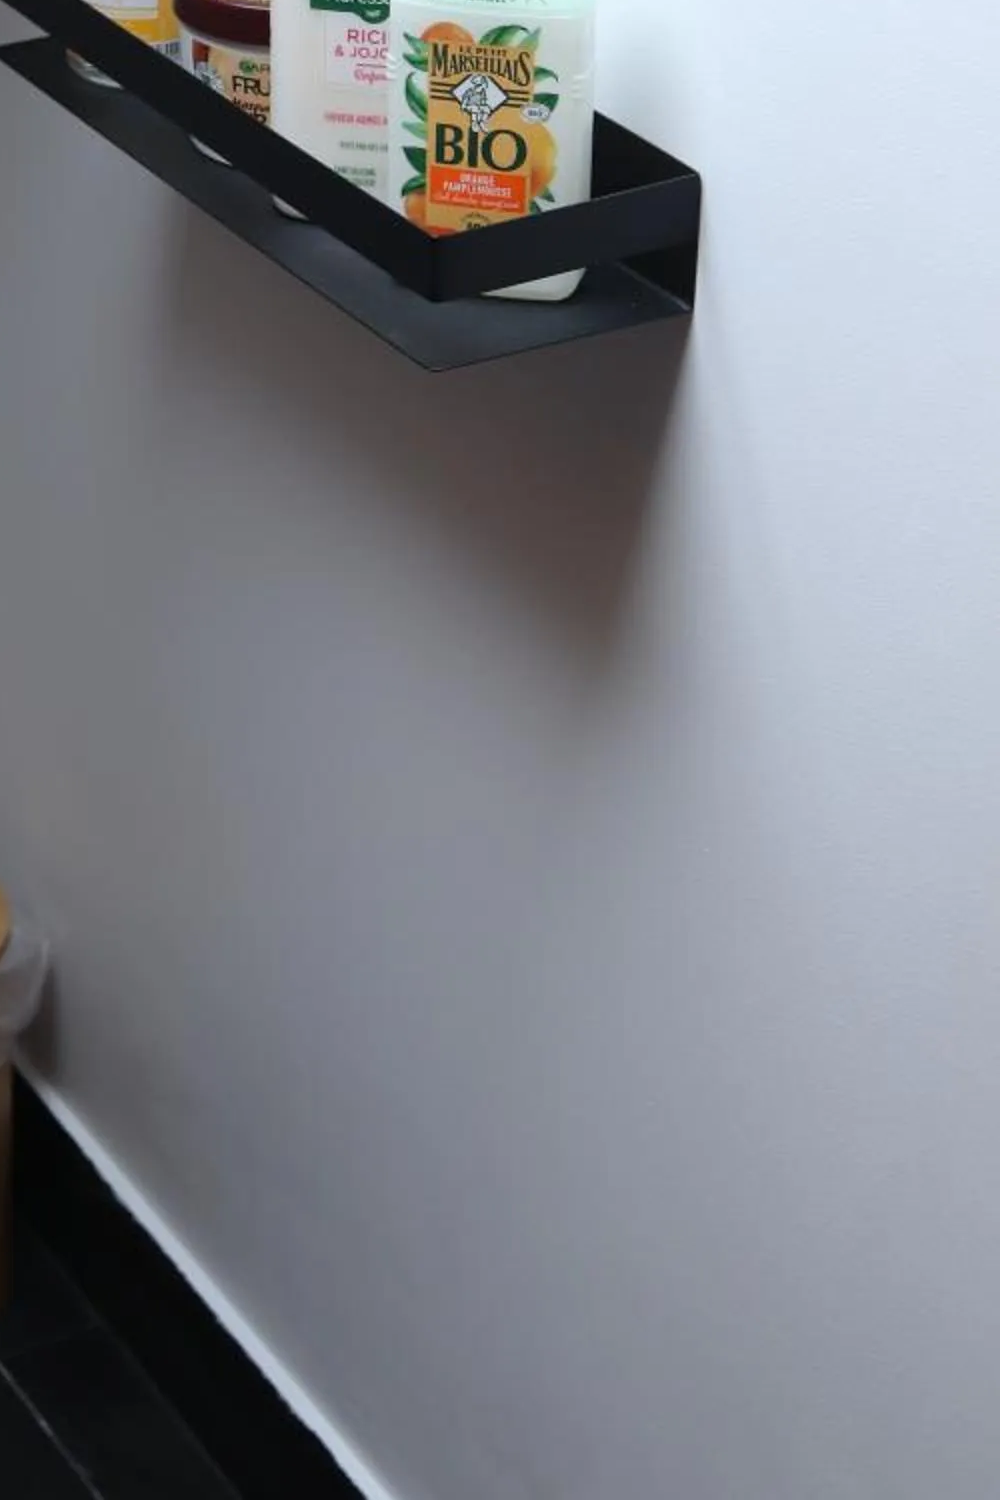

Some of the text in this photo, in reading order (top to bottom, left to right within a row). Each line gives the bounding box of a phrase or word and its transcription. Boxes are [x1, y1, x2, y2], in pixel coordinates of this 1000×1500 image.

[347, 28, 387, 45] RICI
[349, 47, 389, 59] JOJO
[431, 43, 531, 87] MARSEILLAIS
[435, 123, 527, 172] BIO
